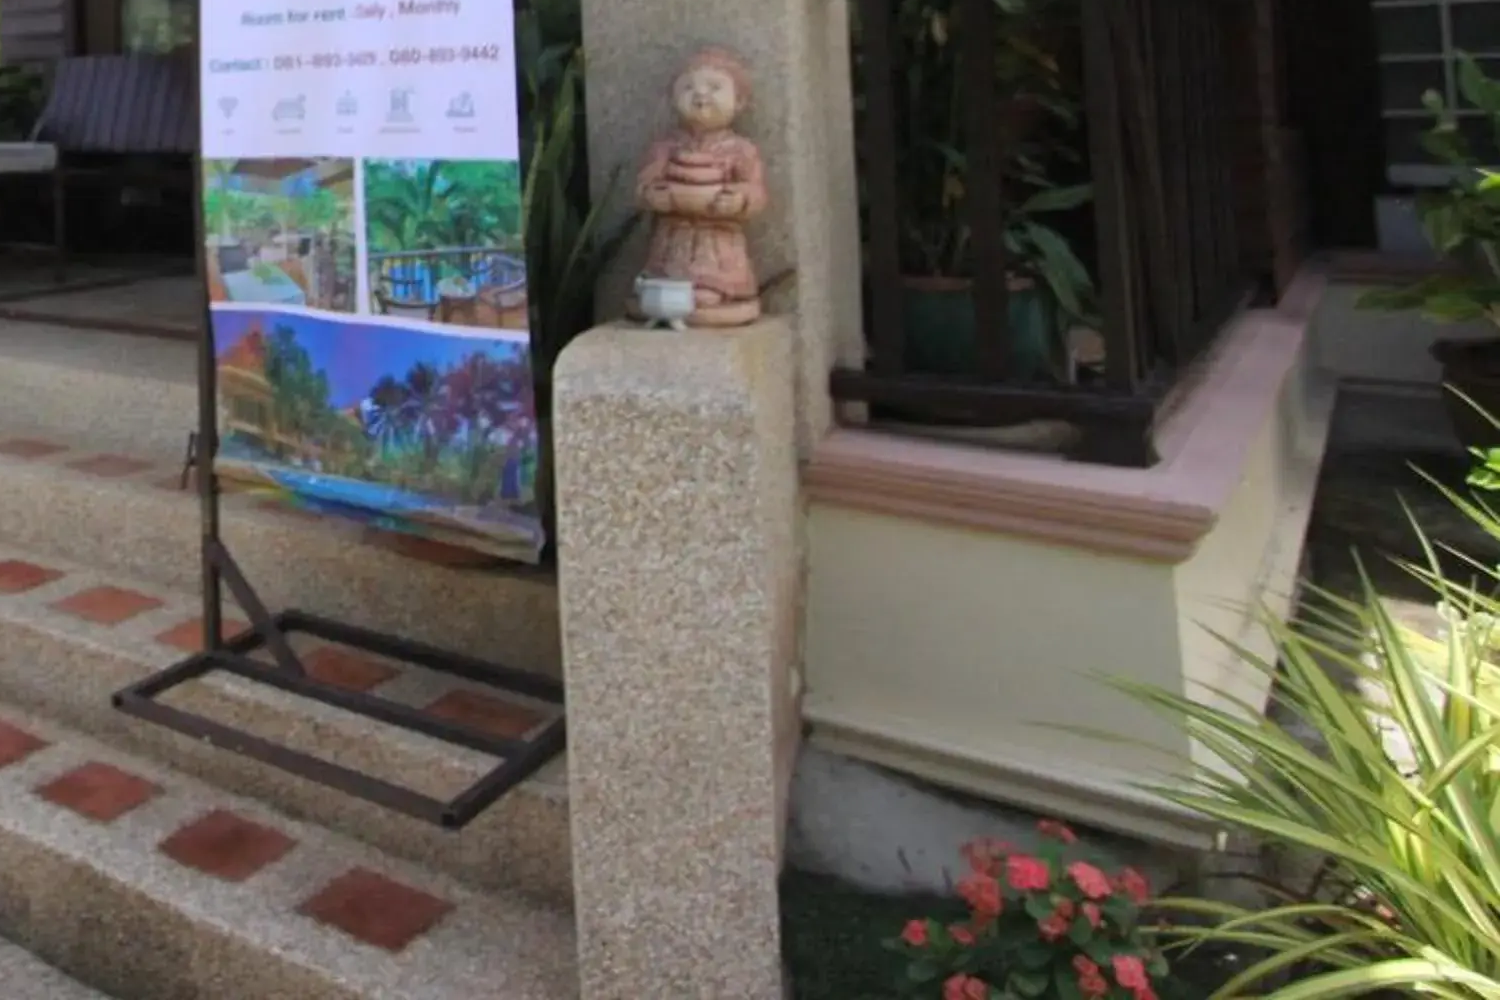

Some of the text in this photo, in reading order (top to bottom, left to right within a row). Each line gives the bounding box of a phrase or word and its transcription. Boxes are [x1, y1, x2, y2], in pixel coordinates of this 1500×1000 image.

[287, 8, 309, 24] for
[314, 7, 346, 23] rent
[209, 57, 262, 74] Contact
